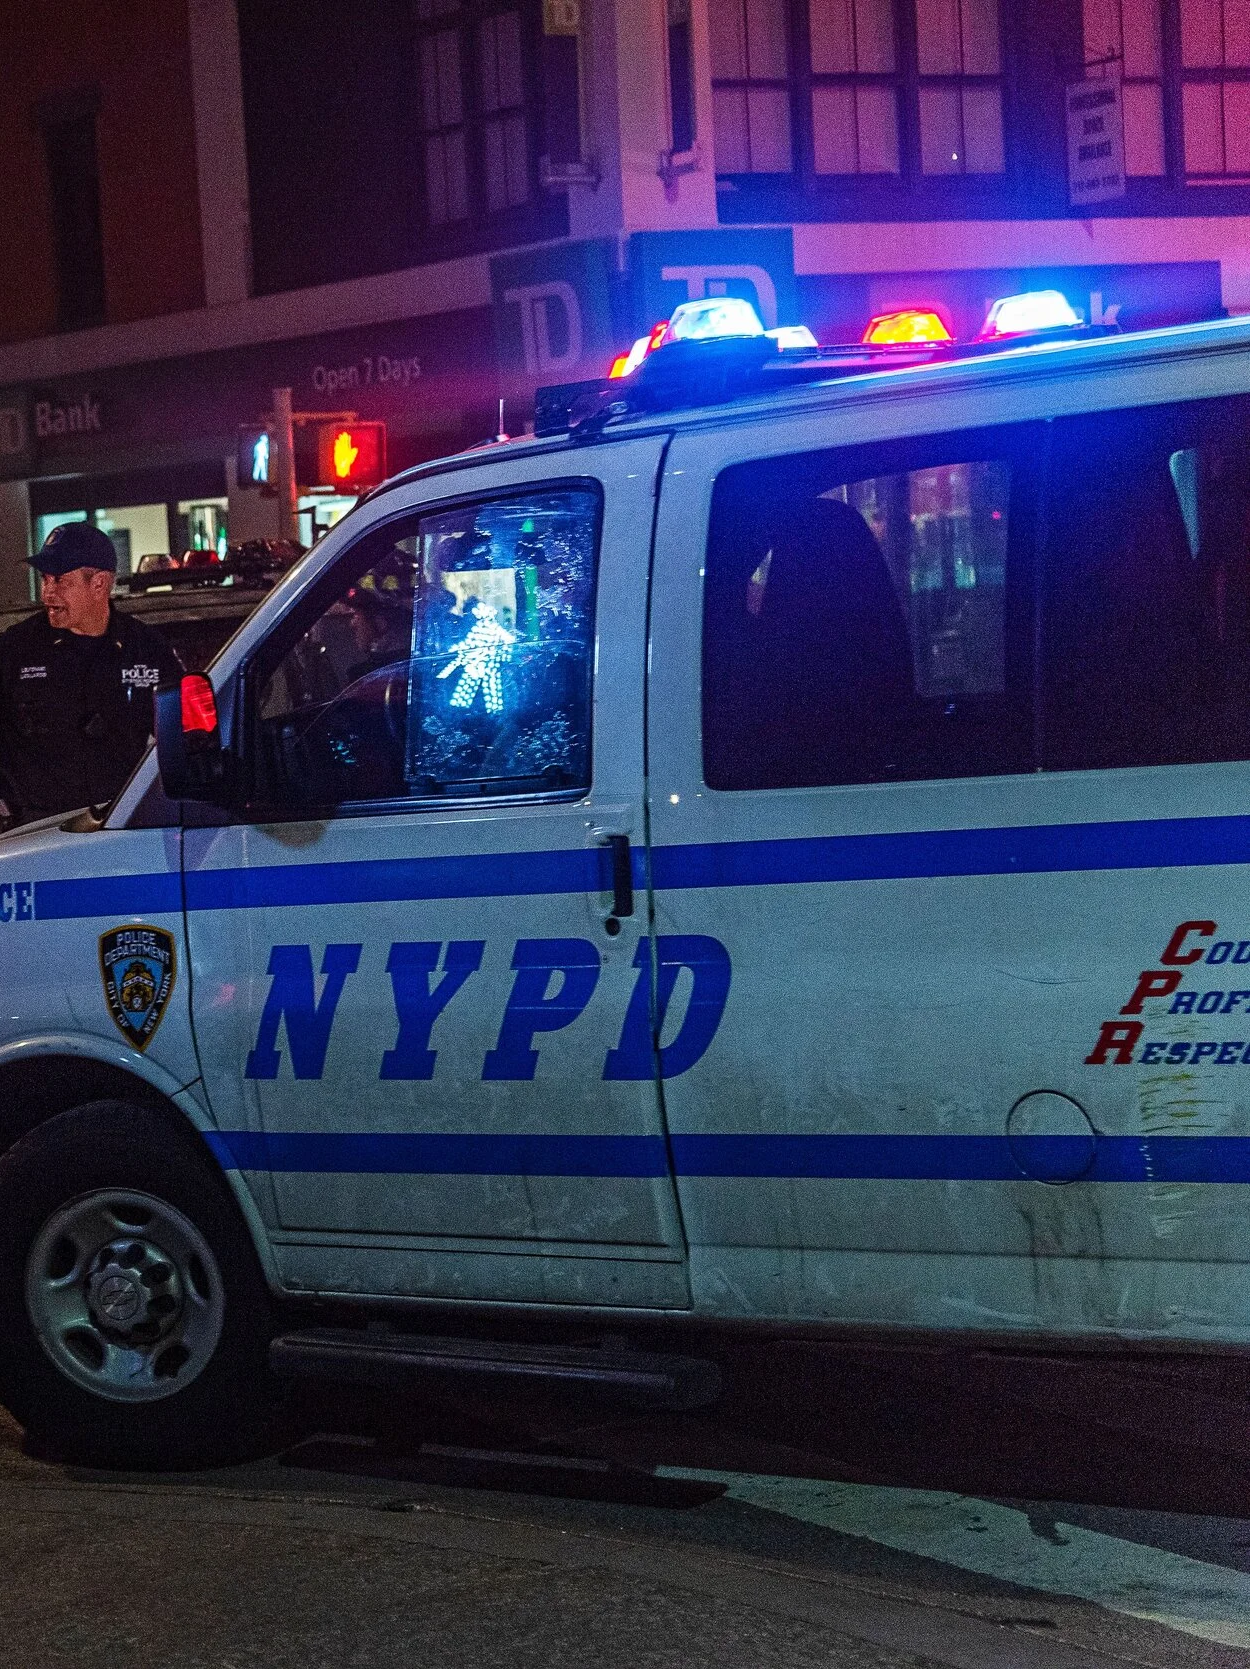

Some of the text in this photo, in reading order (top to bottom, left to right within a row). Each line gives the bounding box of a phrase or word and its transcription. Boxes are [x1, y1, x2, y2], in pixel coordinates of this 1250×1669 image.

[505, 280, 582, 376] TD
[311, 355, 422, 397] Open 7 Days
[35, 392, 102, 437] Bank
[121, 668, 159, 679] POLICE
[104, 943, 170, 966] DEPARTMENT
[116, 931, 157, 946] POLICE
[108, 981, 121, 1009] CITY
[155, 972, 172, 1004] YORK
[244, 933, 733, 1082] NYPD
